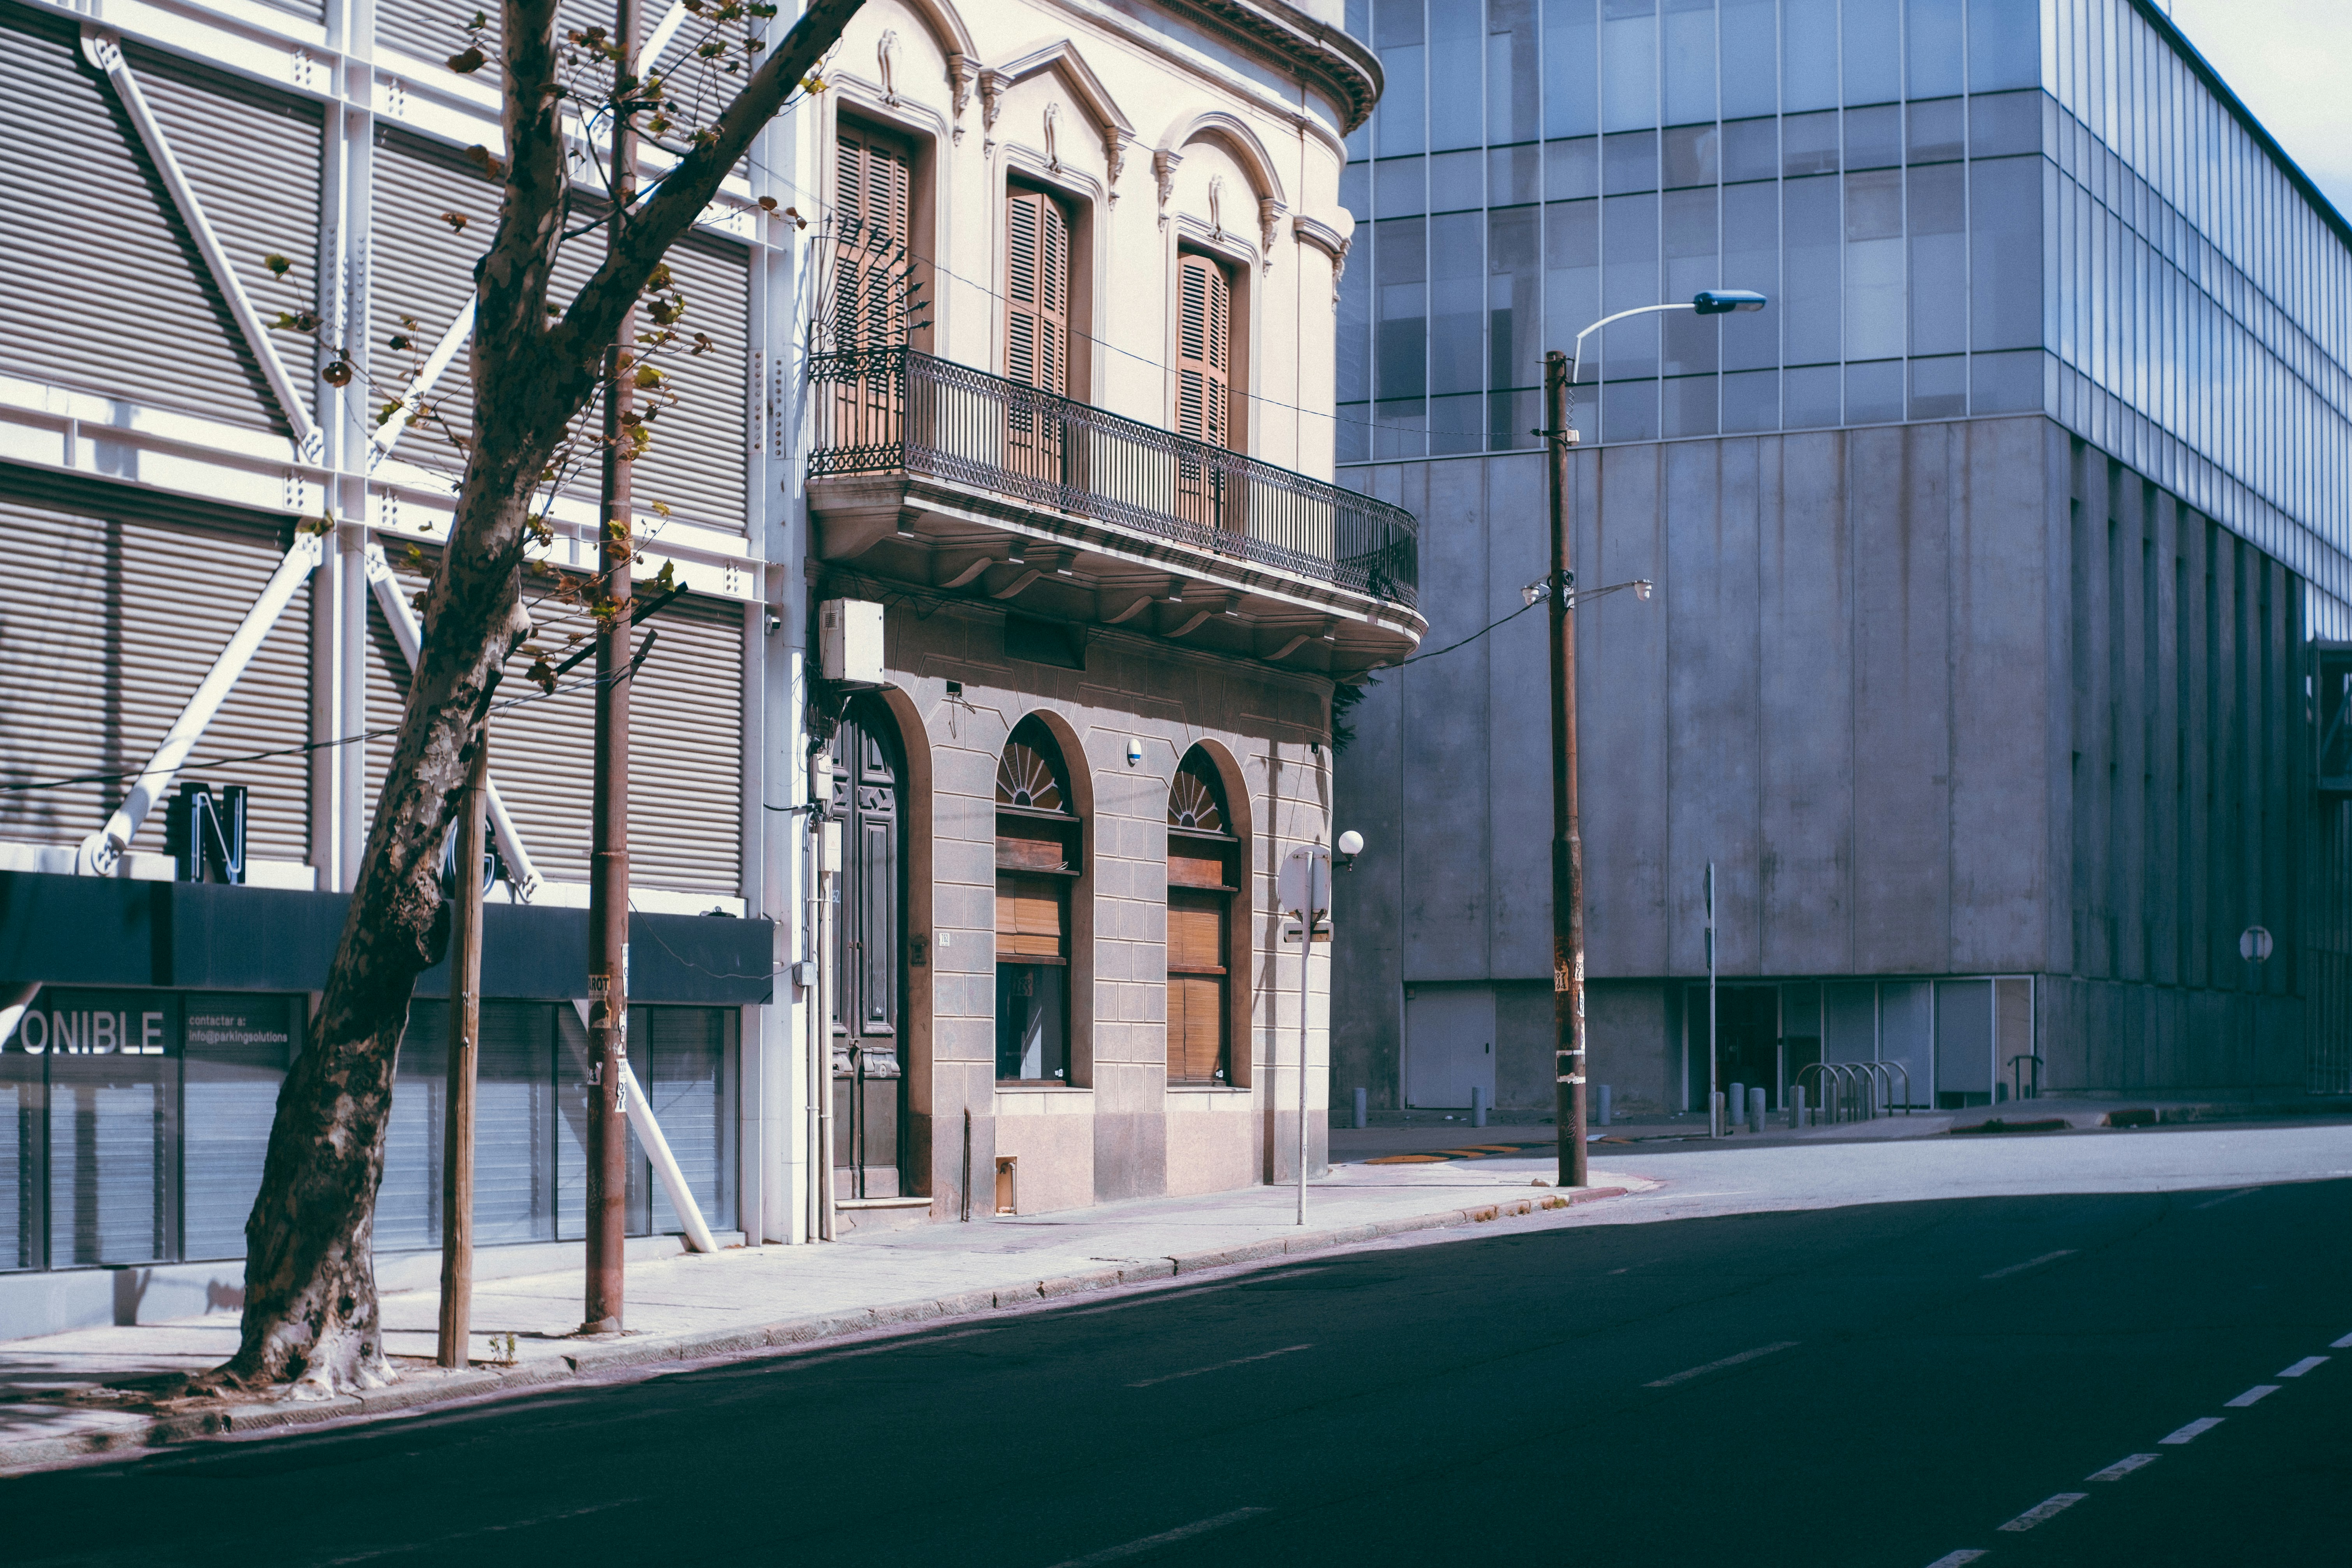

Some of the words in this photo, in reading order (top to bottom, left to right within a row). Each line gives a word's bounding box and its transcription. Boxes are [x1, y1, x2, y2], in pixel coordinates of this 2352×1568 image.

[189, 1014, 234, 1026] contactar
[237, 1017, 246, 1026] a:
[11, 1010, 164, 1054] ONIBLE
[188, 1029, 288, 1045] info@parkingsolutions
